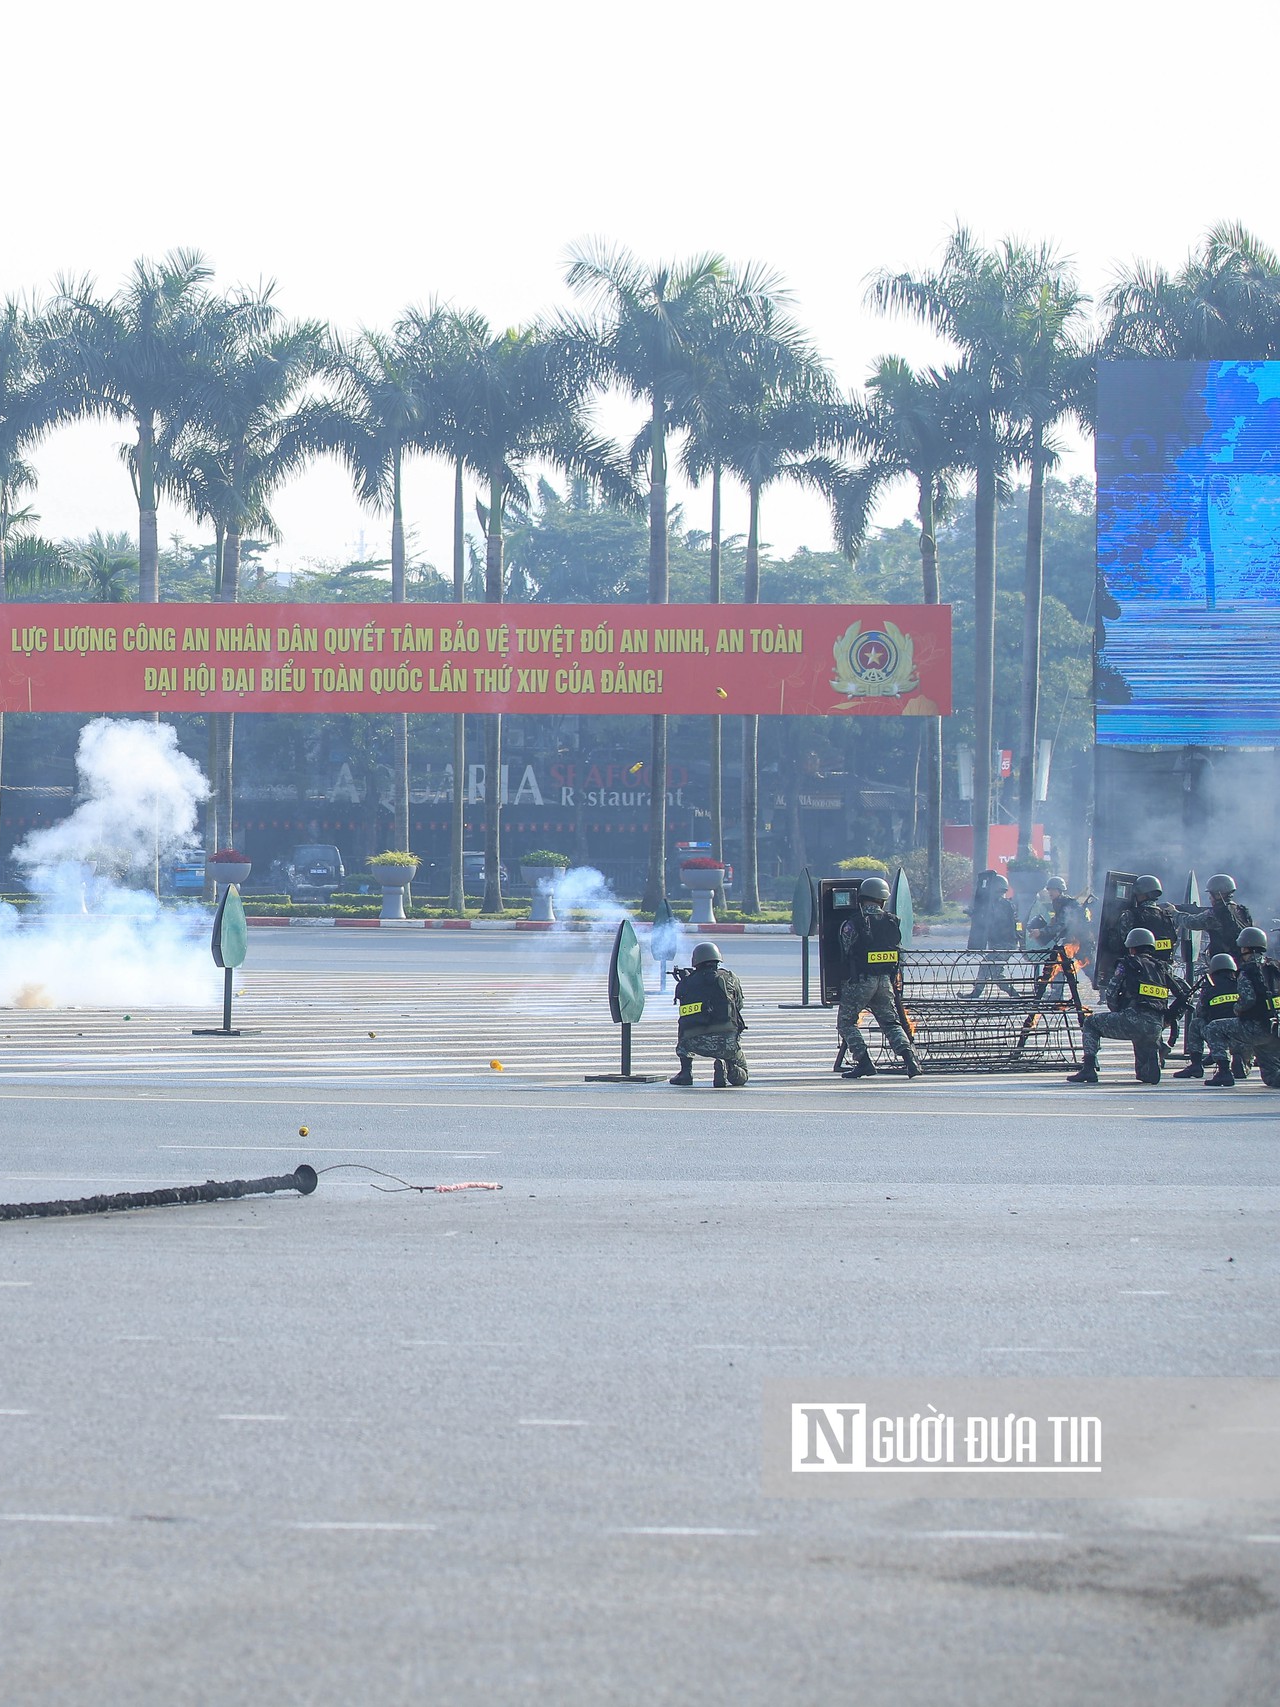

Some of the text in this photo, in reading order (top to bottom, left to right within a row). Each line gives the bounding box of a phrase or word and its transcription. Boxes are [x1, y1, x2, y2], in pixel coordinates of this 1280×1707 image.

[11, 620, 802, 658] LỰC LƯỢNG CÔNG AN NHÂN DÂN QUYẾT TÂM BẢO VỆ TUYỆT ĐỐI AN NINH, AN TOÀN
[144, 658, 663, 697] ĐẠI HỘI ĐẠI BIỂU TOÀN QUỐC LẦN THỨ XIV CỦA ĐẢNG!
[561, 786, 684, 807] Rstaurnt
